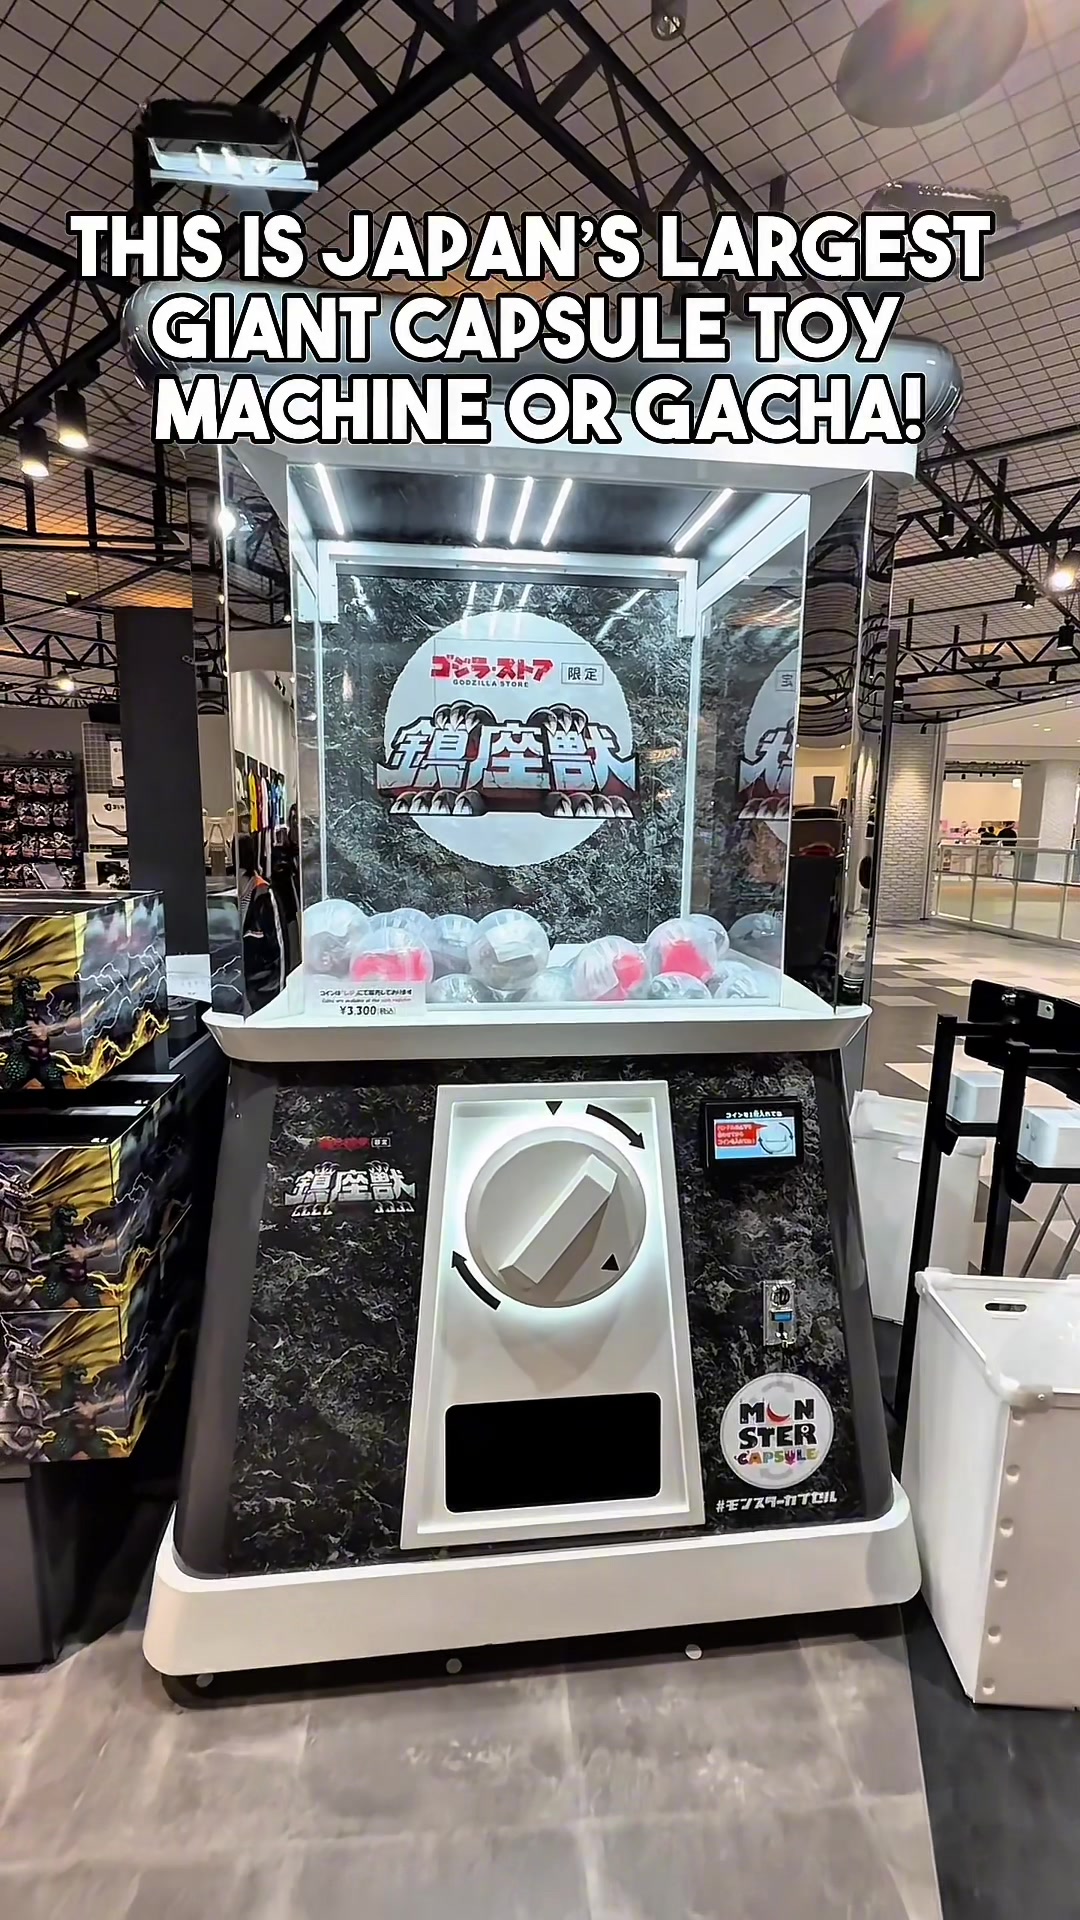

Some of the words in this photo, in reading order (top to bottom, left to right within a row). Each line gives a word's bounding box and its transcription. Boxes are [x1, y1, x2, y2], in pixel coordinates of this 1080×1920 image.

[567, 666, 599, 682] 限定
[452, 678, 498, 688] GODZILLA
[499, 680, 529, 689] STORE
[734, 1448, 818, 1466] CAPSULE
